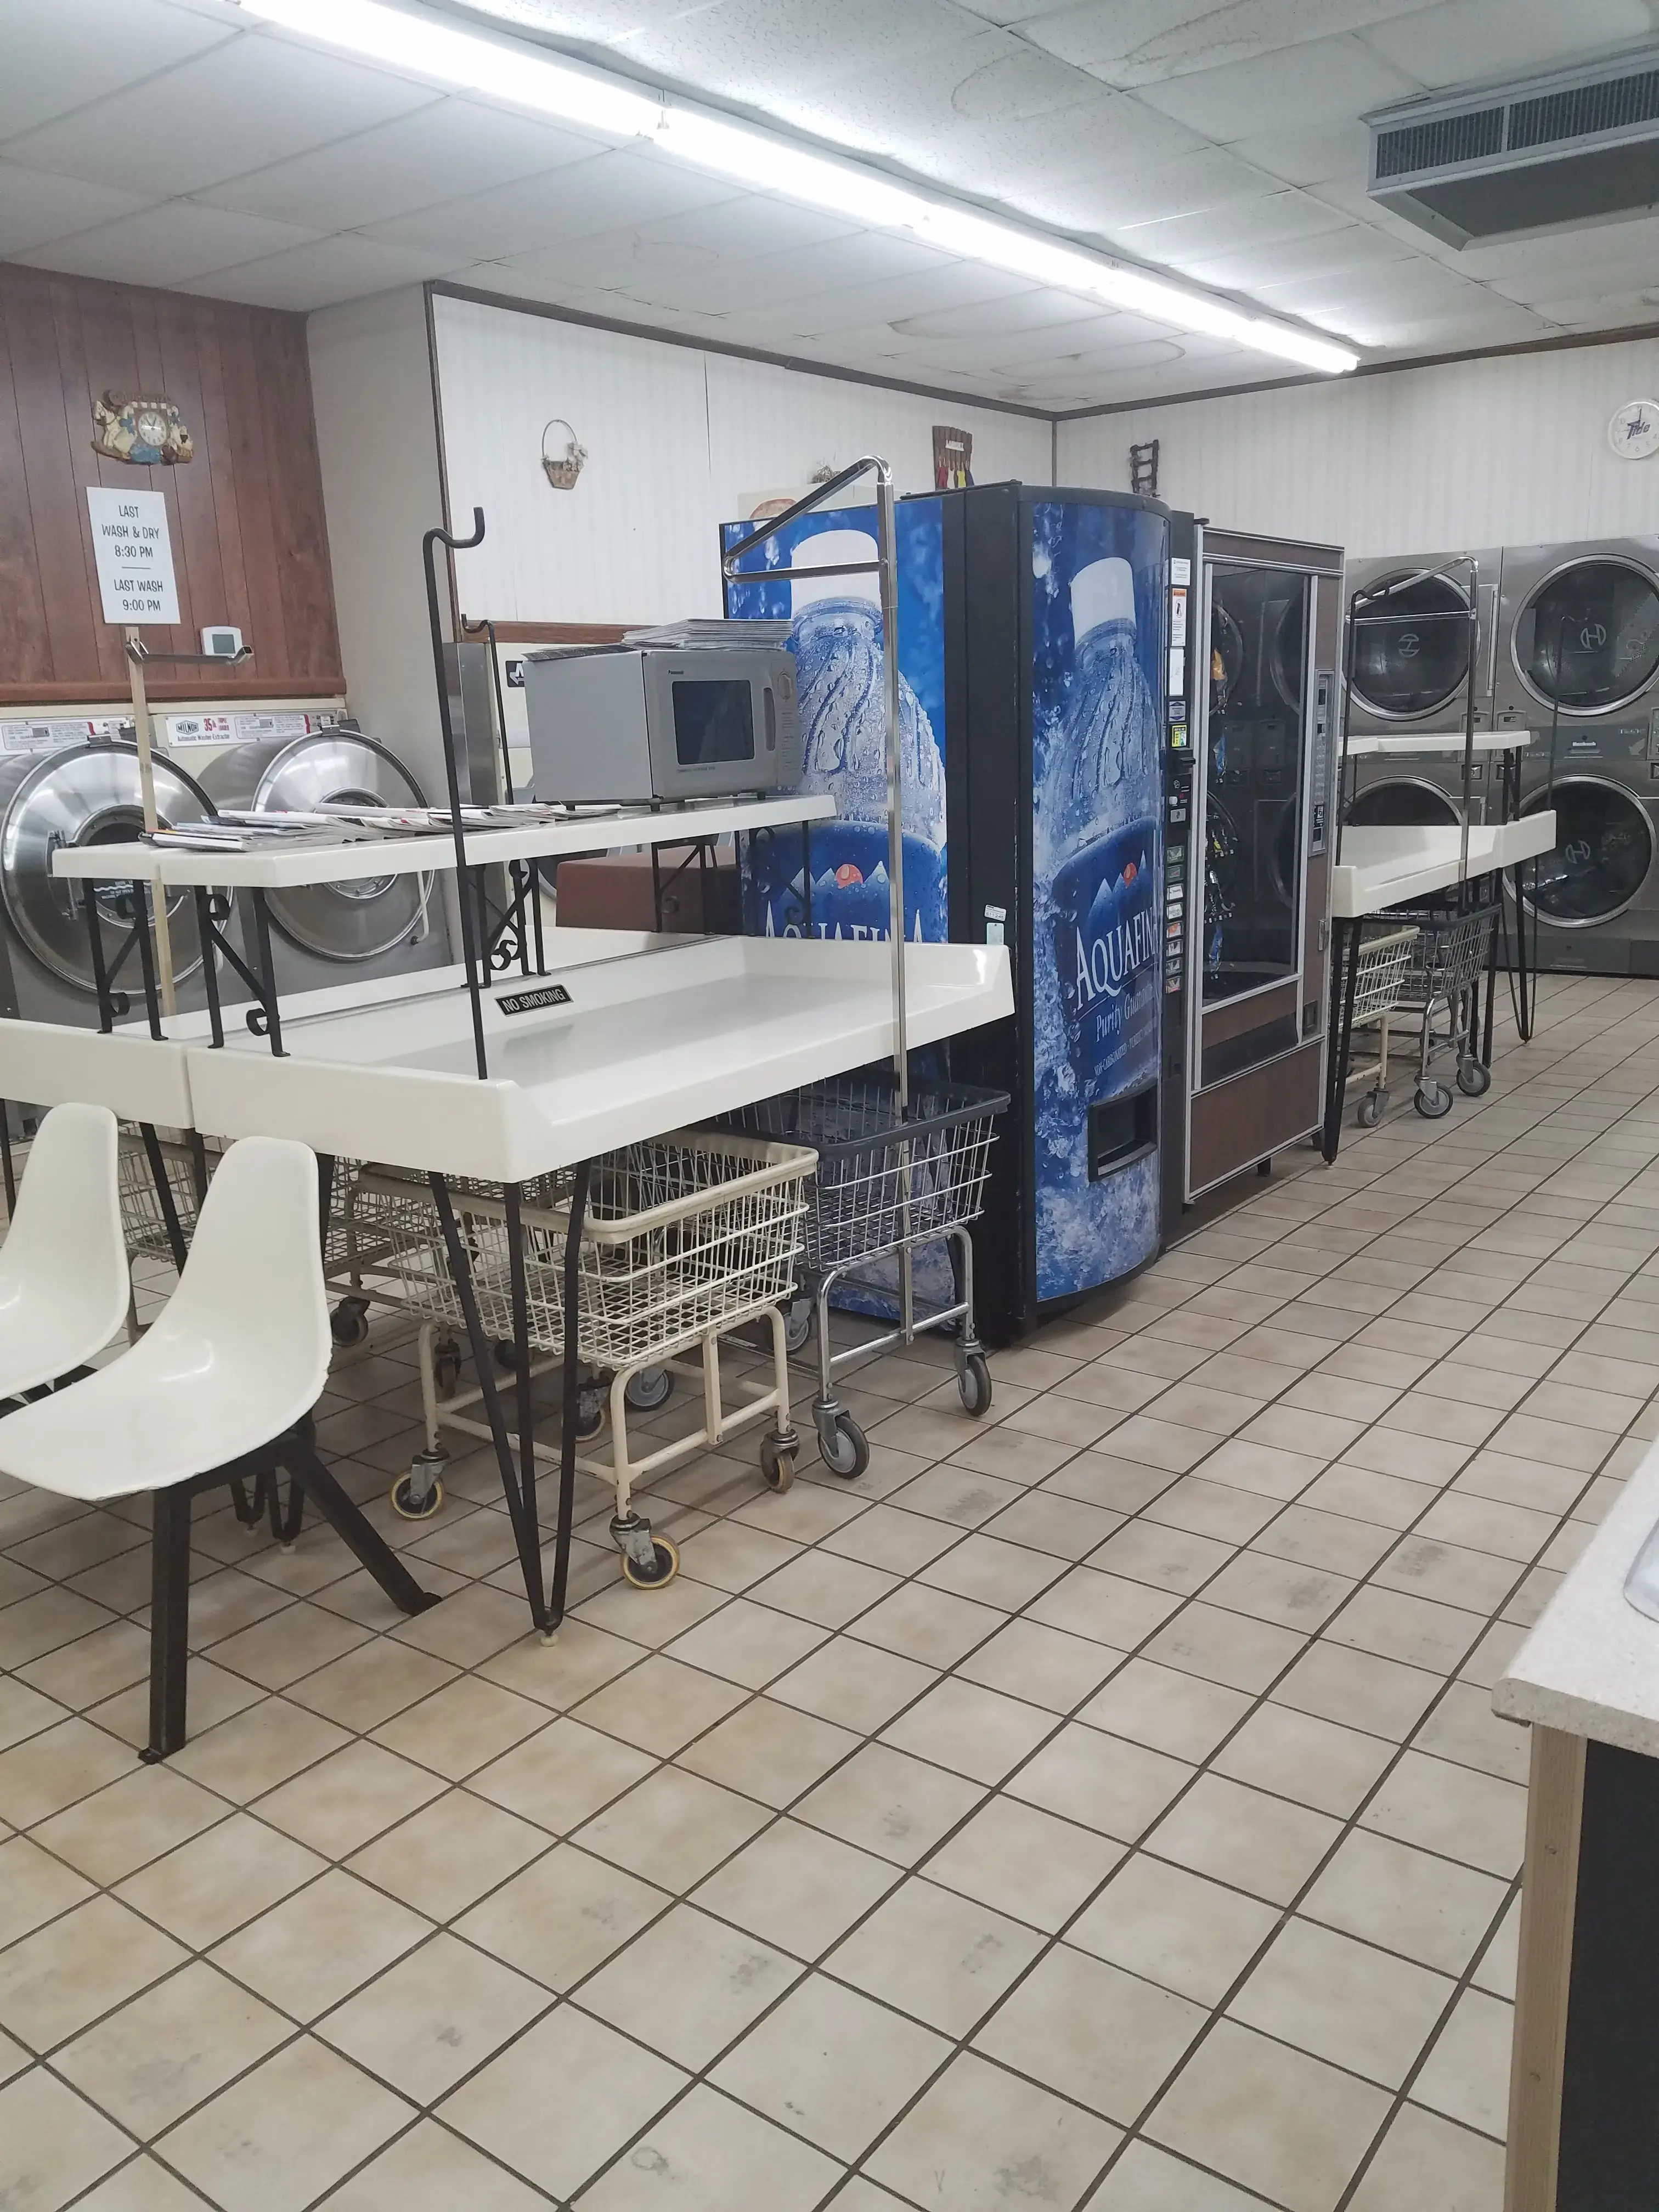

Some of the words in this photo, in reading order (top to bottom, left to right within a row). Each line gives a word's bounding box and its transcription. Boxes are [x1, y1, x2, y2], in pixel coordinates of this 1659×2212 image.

[1626, 420, 1651, 440] Tide
[119, 505, 139, 518] LAST
[101, 523, 129, 538] WASH
[133, 526, 140, 538] &
[142, 526, 160, 539] DRY
[114, 545, 137, 557] 8:30
[139, 546, 154, 558] PM
[114, 579, 134, 592] LAST
[137, 580, 163, 592] WASH
[122, 599, 144, 611] 9:00
[148, 600, 161, 612] PM
[177, 723, 198, 733] MILNOR
[204, 718, 213, 731] 35
[502, 998, 520, 1012] NO
[519, 989, 566, 1008] SMOKING
[1096, 1003, 1122, 1042] Purity
